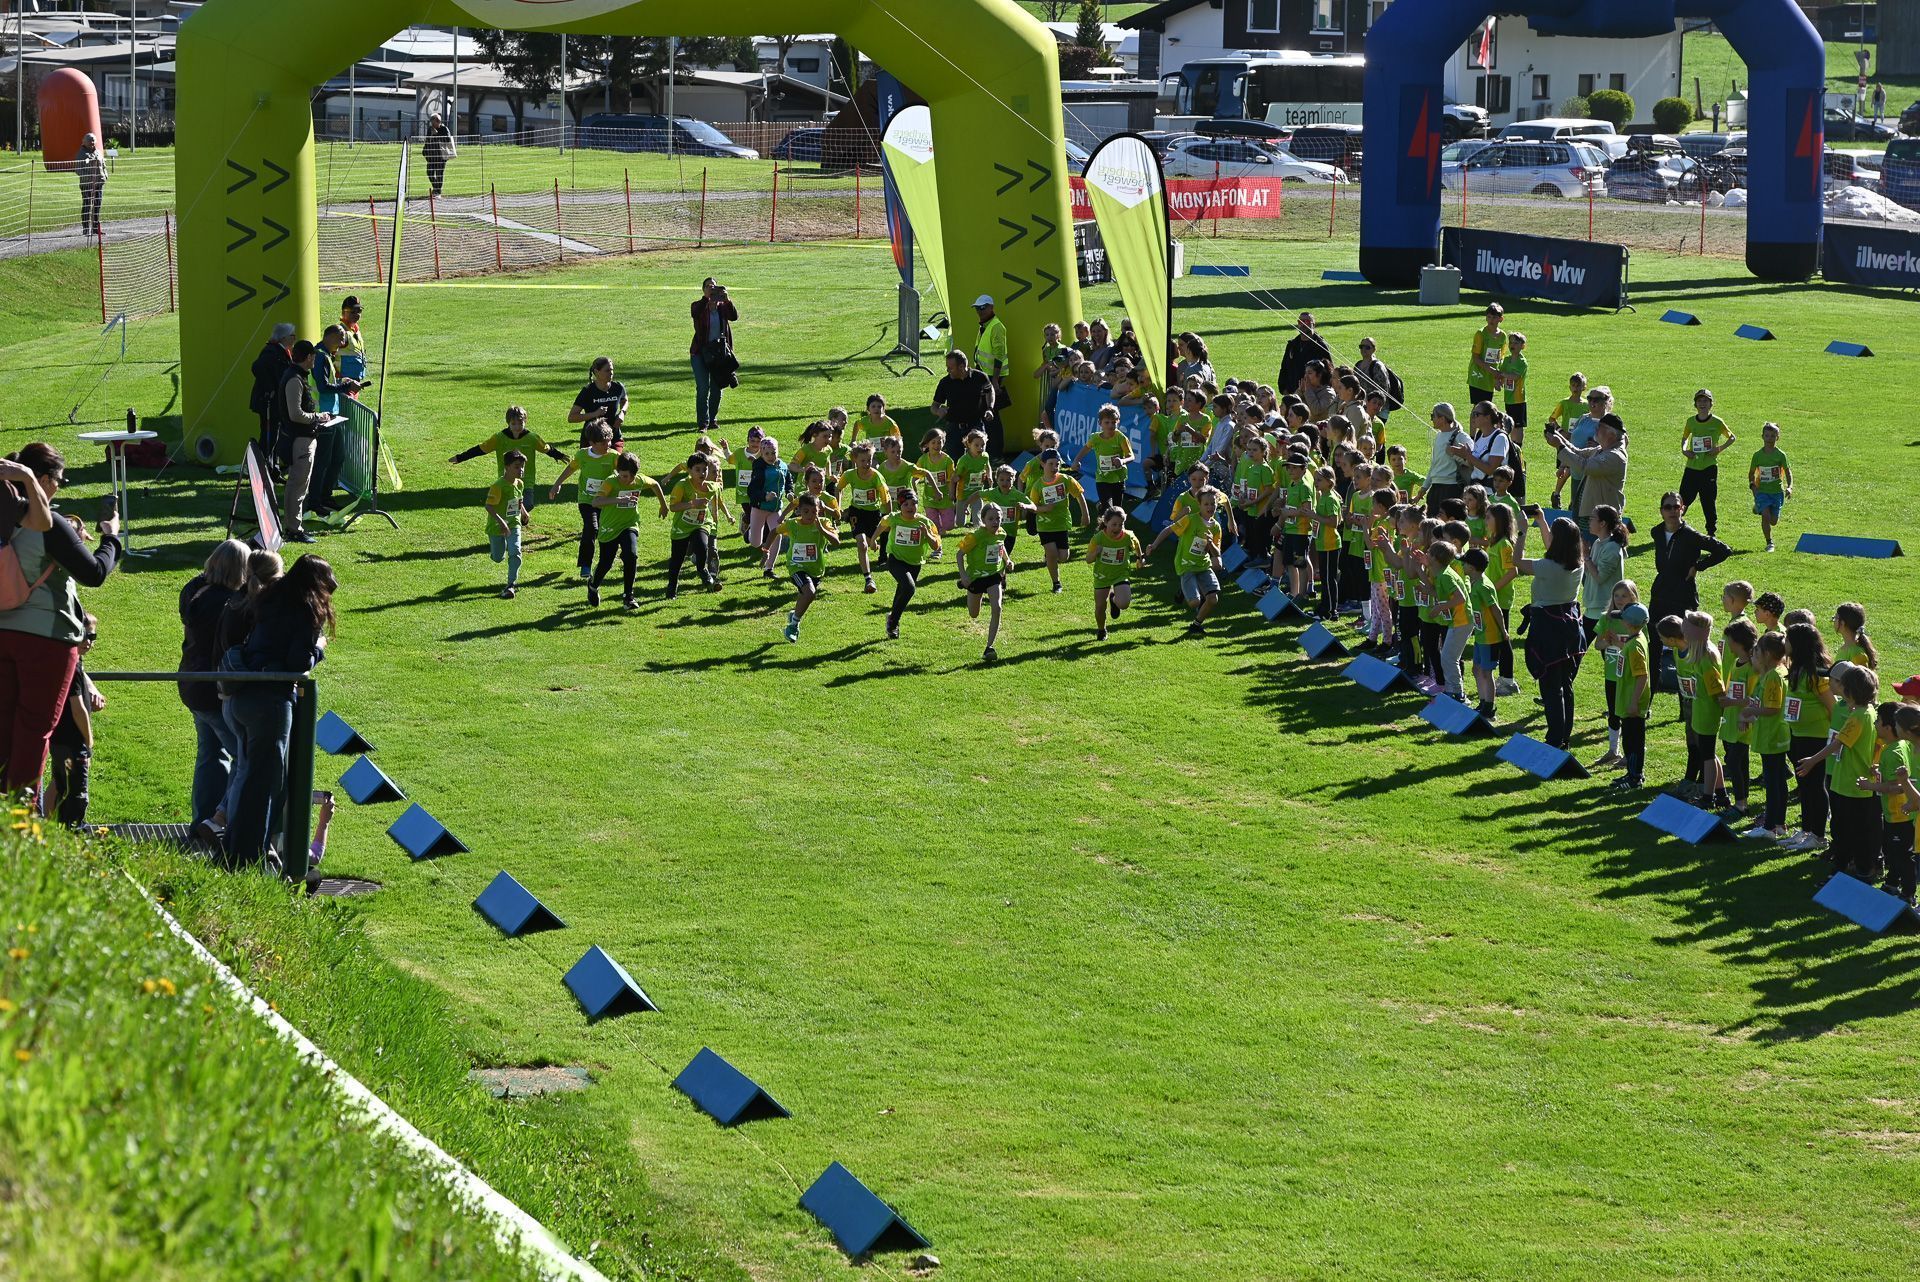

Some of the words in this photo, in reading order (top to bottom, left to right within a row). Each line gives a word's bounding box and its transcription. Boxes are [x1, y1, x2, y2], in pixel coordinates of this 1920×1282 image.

[1285, 105, 1347, 126] teamliner
[1171, 188, 1270, 209] MONTAFON.AT
[1476, 248, 1543, 280] illwerke
[1552, 259, 1586, 285] vkw
